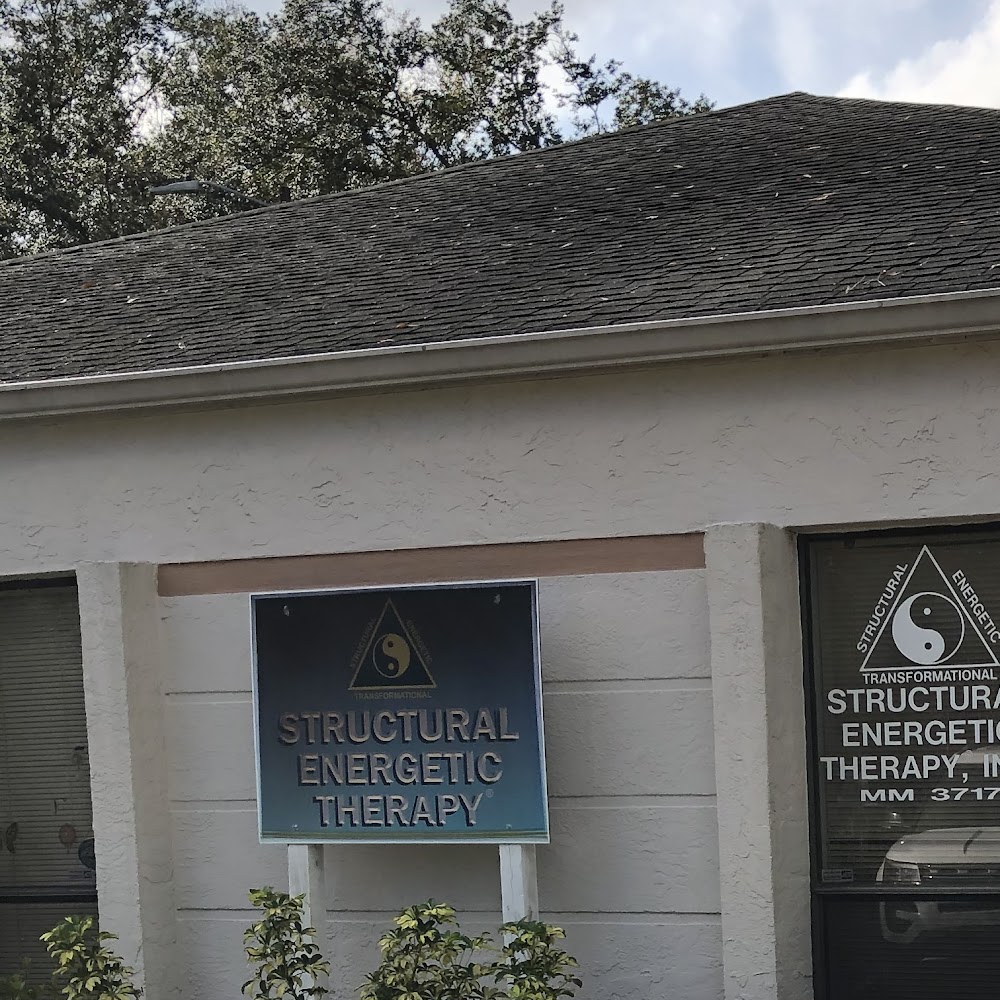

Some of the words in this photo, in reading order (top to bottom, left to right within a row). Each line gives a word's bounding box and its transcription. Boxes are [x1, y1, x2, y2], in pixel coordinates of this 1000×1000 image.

[856, 562, 908, 654] STRUCTURAL
[862, 668, 998, 685] TRANSFORMATIONAL
[354, 691, 432, 700] TRANSFORMATIONAL
[278, 707, 520, 745] STRUCTURAL
[299, 751, 503, 786] ENERGETIC
[819, 755, 968, 783] THERAPY,
[860, 789, 914, 802] MM
